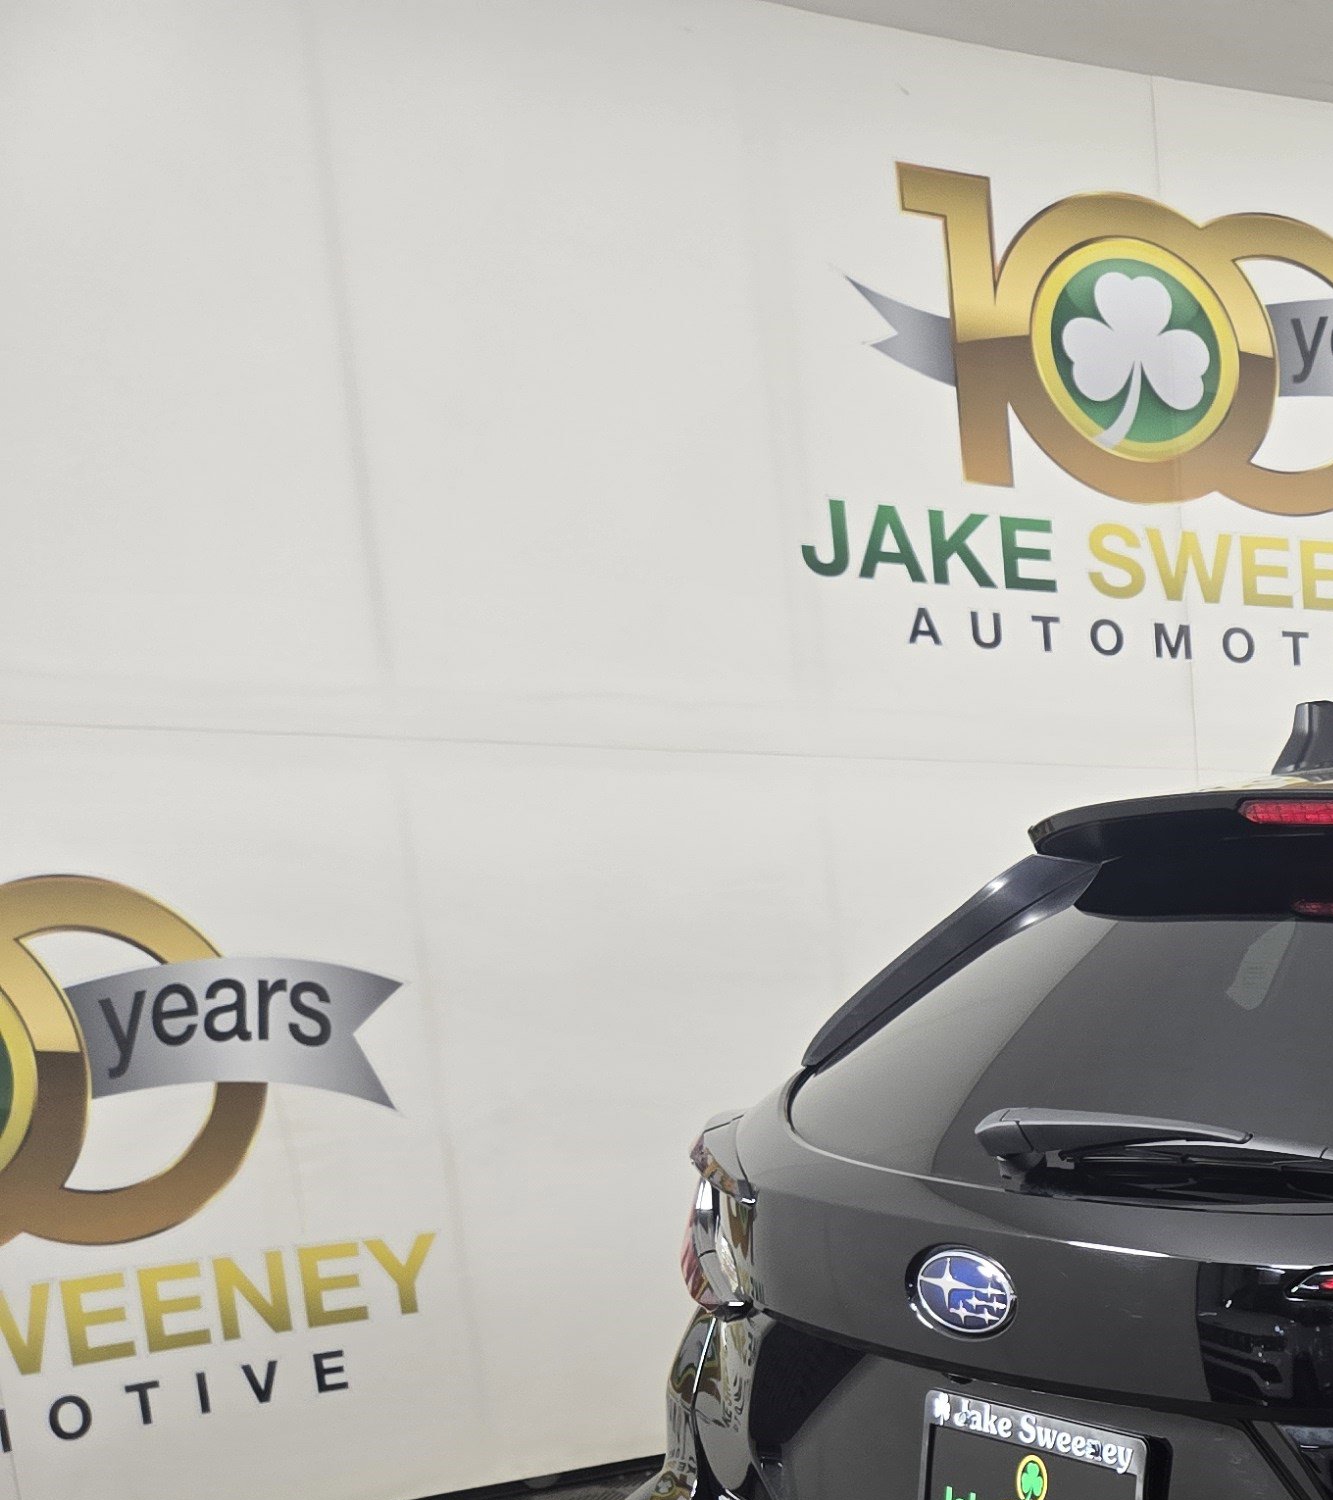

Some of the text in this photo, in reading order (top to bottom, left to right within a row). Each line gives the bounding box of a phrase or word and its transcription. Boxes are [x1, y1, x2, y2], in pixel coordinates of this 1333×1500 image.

[801, 499, 1059, 595] JAKE
[98, 977, 333, 1079] years
[953, 1397, 1134, 1475] Jake Sweeney
